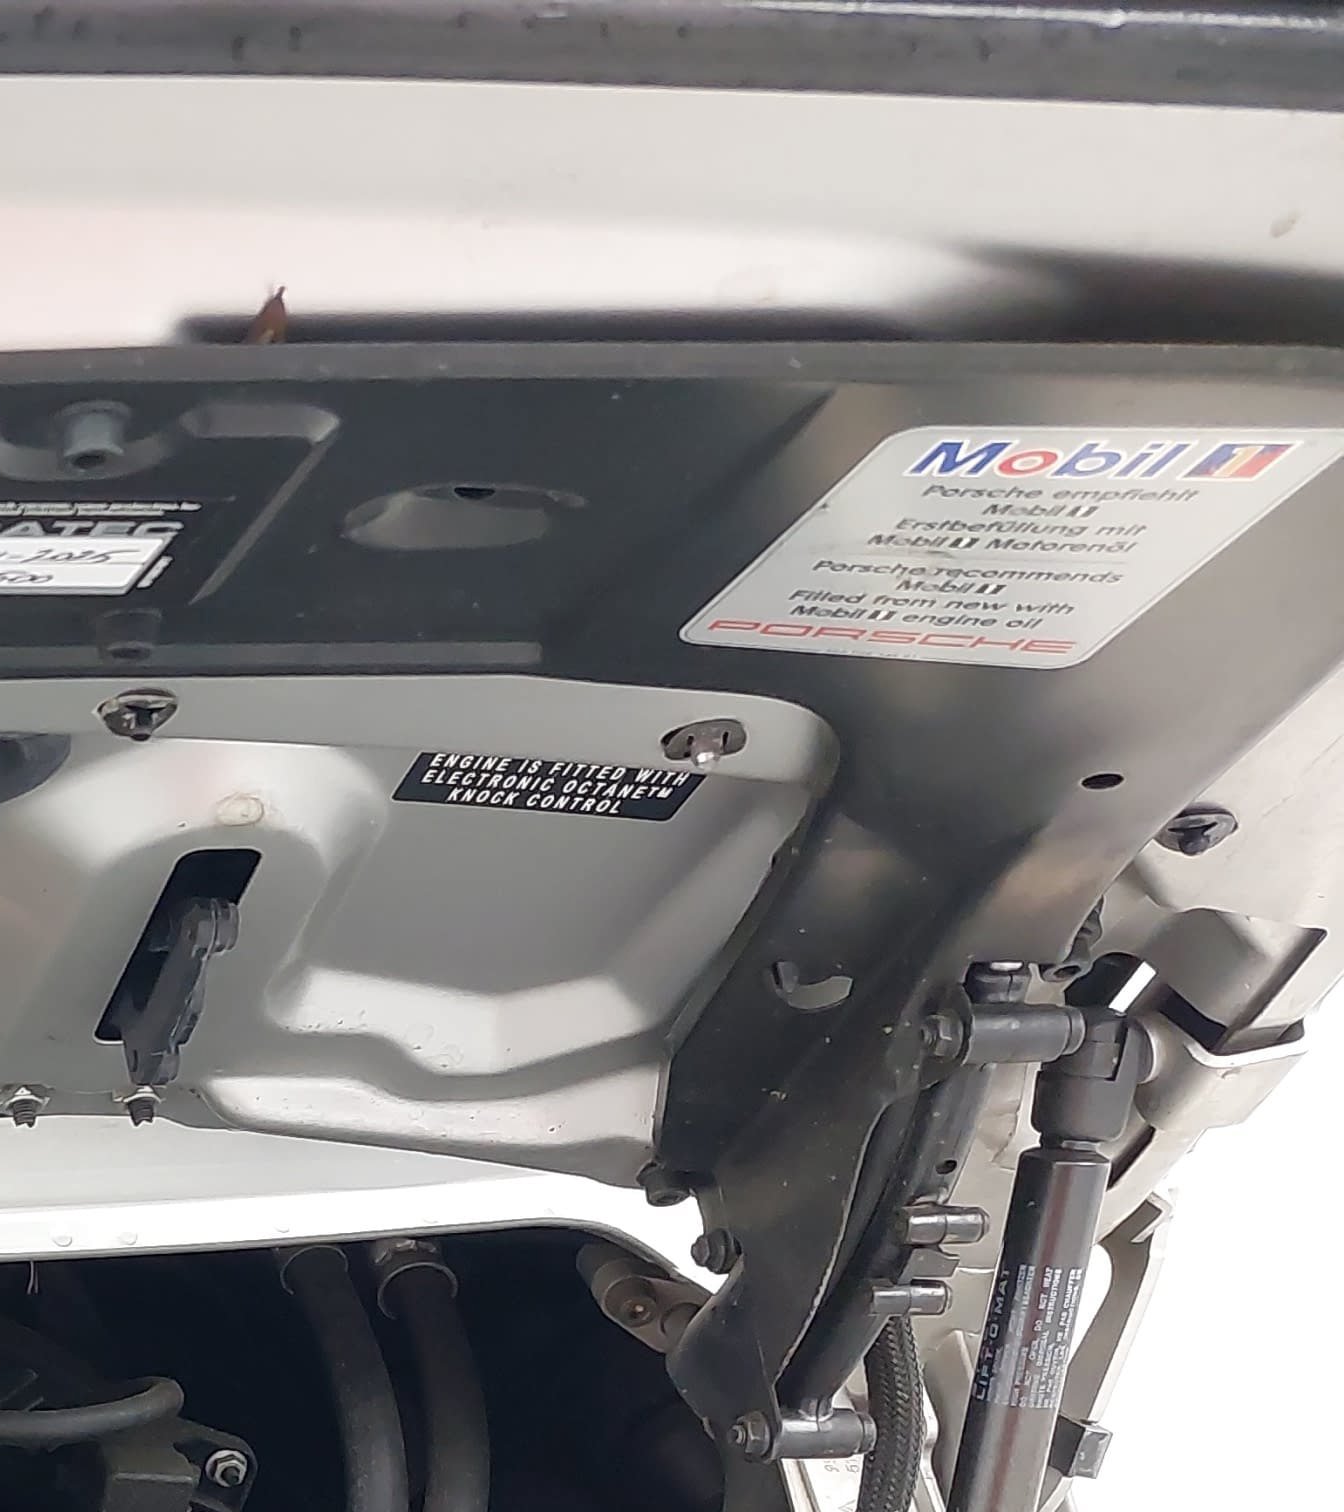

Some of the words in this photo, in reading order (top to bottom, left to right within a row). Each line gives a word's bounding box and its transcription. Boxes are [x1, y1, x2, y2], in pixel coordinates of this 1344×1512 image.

[914, 442, 1190, 478] Mobil
[923, 484, 1042, 501] Porsche
[1052, 487, 1198, 504] empfiehlt
[982, 503, 1068, 518] Mobil
[895, 517, 1089, 538] Erstbefüllung
[1094, 523, 1148, 537] mit
[868, 533, 947, 549] Mobil
[985, 538, 1138, 554] Motorenöl
[812, 559, 926, 578] Porsche
[932, 566, 1124, 584] recommends
[895, 579, 978, 595] Mobil
[789, 589, 866, 606] Filled
[873, 593, 937, 609] from
[946, 600, 1009, 613] new
[1015, 601, 1075, 616] with
[790, 604, 867, 620] Mobil
[901, 613, 998, 630] engine
[1005, 617, 1043, 631] oil
[708, 619, 1078, 655] PORSCHE
[421, 769, 556, 793] ELECTRONIC
[430, 752, 511, 772] ENGINE
[517, 758, 543, 775] IS
[549, 762, 627, 782] FITTED
[637, 769, 691, 787] WITH
[447, 787, 520, 806] KNOCK
[526, 793, 622, 815] CONTROL
